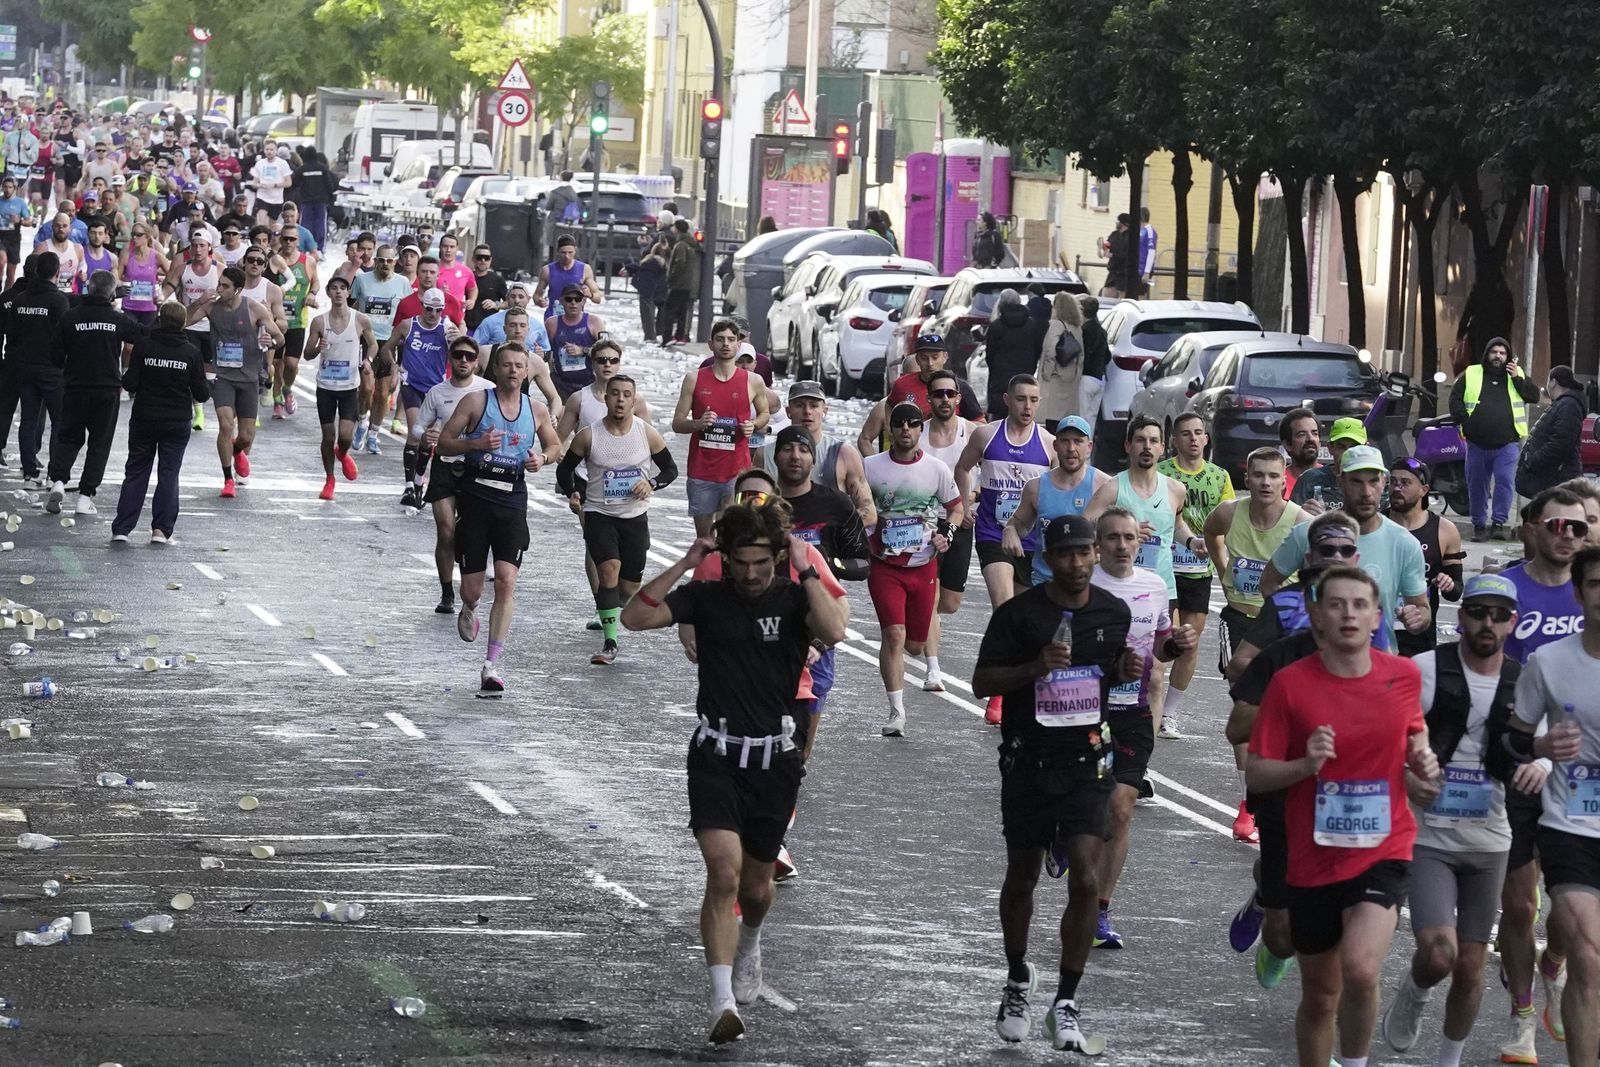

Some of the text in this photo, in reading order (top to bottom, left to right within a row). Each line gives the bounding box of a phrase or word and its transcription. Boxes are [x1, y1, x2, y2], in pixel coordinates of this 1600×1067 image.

[504, 102, 525, 115] 30
[17, 307, 48, 316] VOLUNTEER
[75, 322, 116, 332] VOLUNTEER
[144, 357, 188, 370] VOLUNTEER
[704, 433, 732, 442] TIMMER
[494, 456, 516, 464] ZURICH
[616, 470, 638, 478] ZURICH
[989, 478, 1025, 488] FINN VALLE
[895, 518, 918, 527] ZURICH
[1172, 555, 1198, 564] JULIAN
[757, 616, 781, 635] W
[1056, 669, 1092, 680] ZURICH
[1056, 687, 1080, 697] 12111
[1037, 697, 1099, 713] FERNANDO
[1343, 783, 1381, 794] ZURICH
[1582, 799, 1600, 813] TO
[1326, 816, 1380, 831] GEORGE
